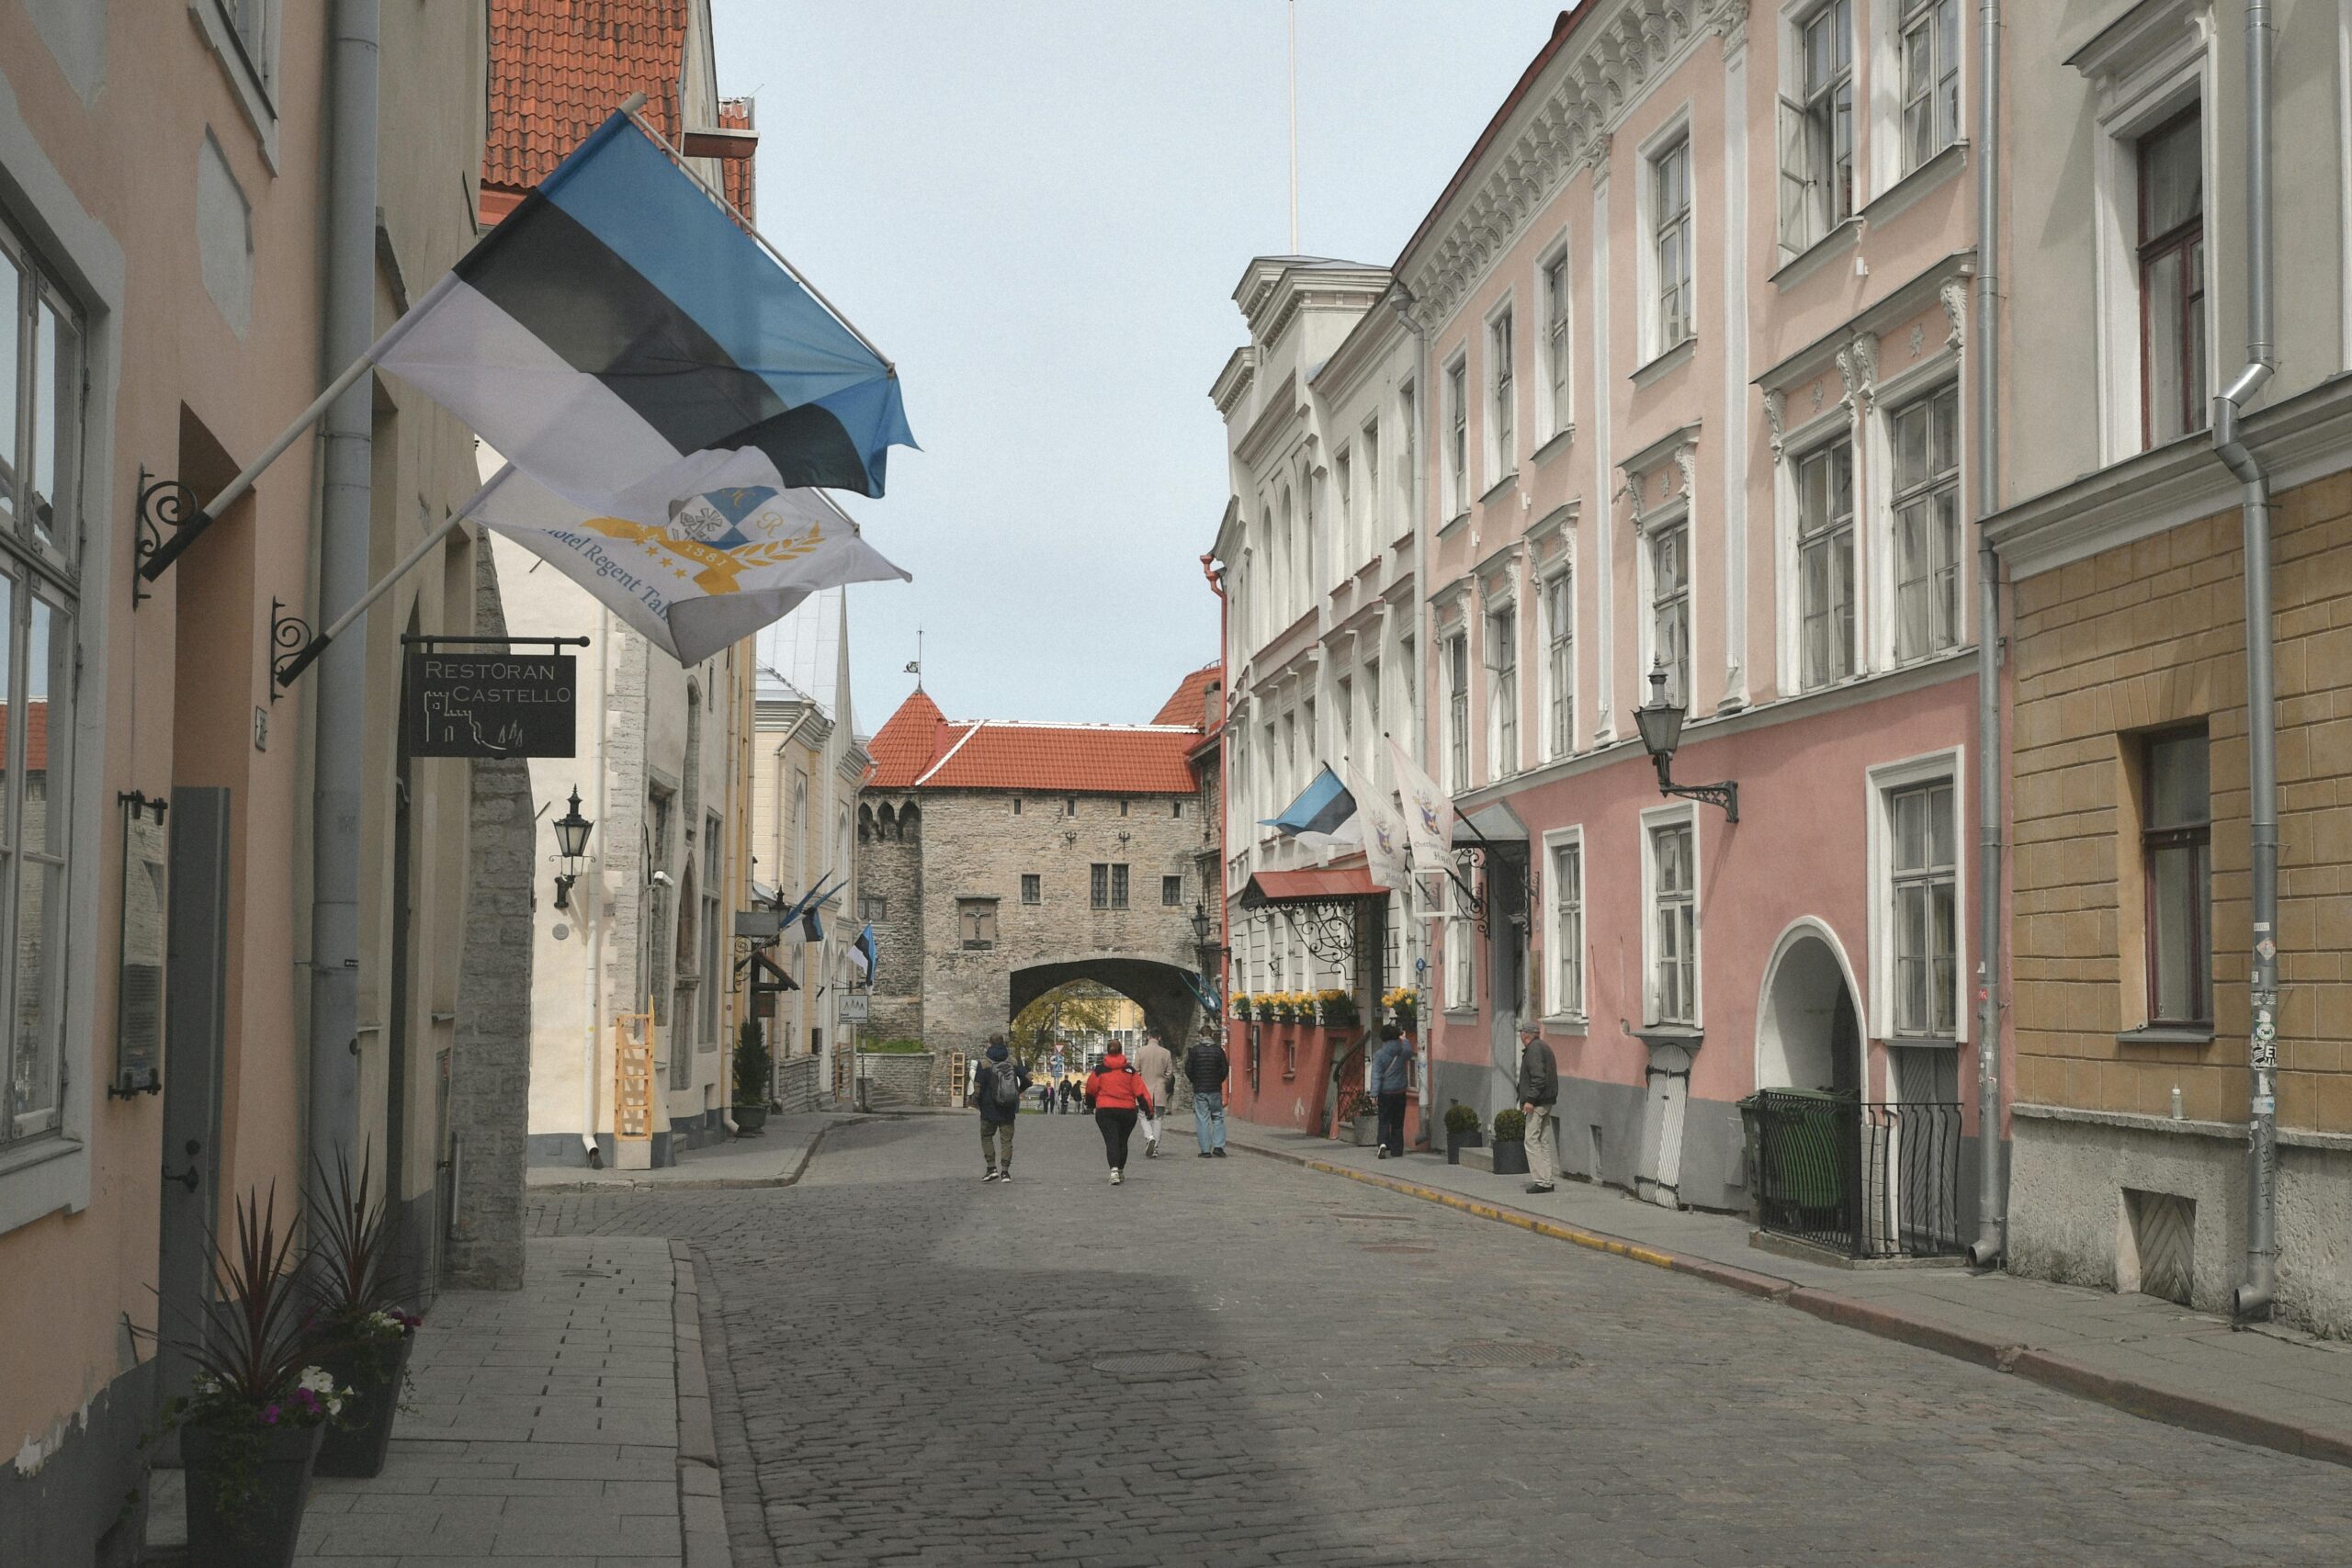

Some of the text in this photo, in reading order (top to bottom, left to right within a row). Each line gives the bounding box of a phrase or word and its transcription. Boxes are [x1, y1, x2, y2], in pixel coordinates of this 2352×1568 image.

[541, 528, 591, 551] otel
[582, 544, 642, 592] Regent
[425, 660, 555, 680] RESTORAN
[452, 685, 571, 703] CASTELLO
